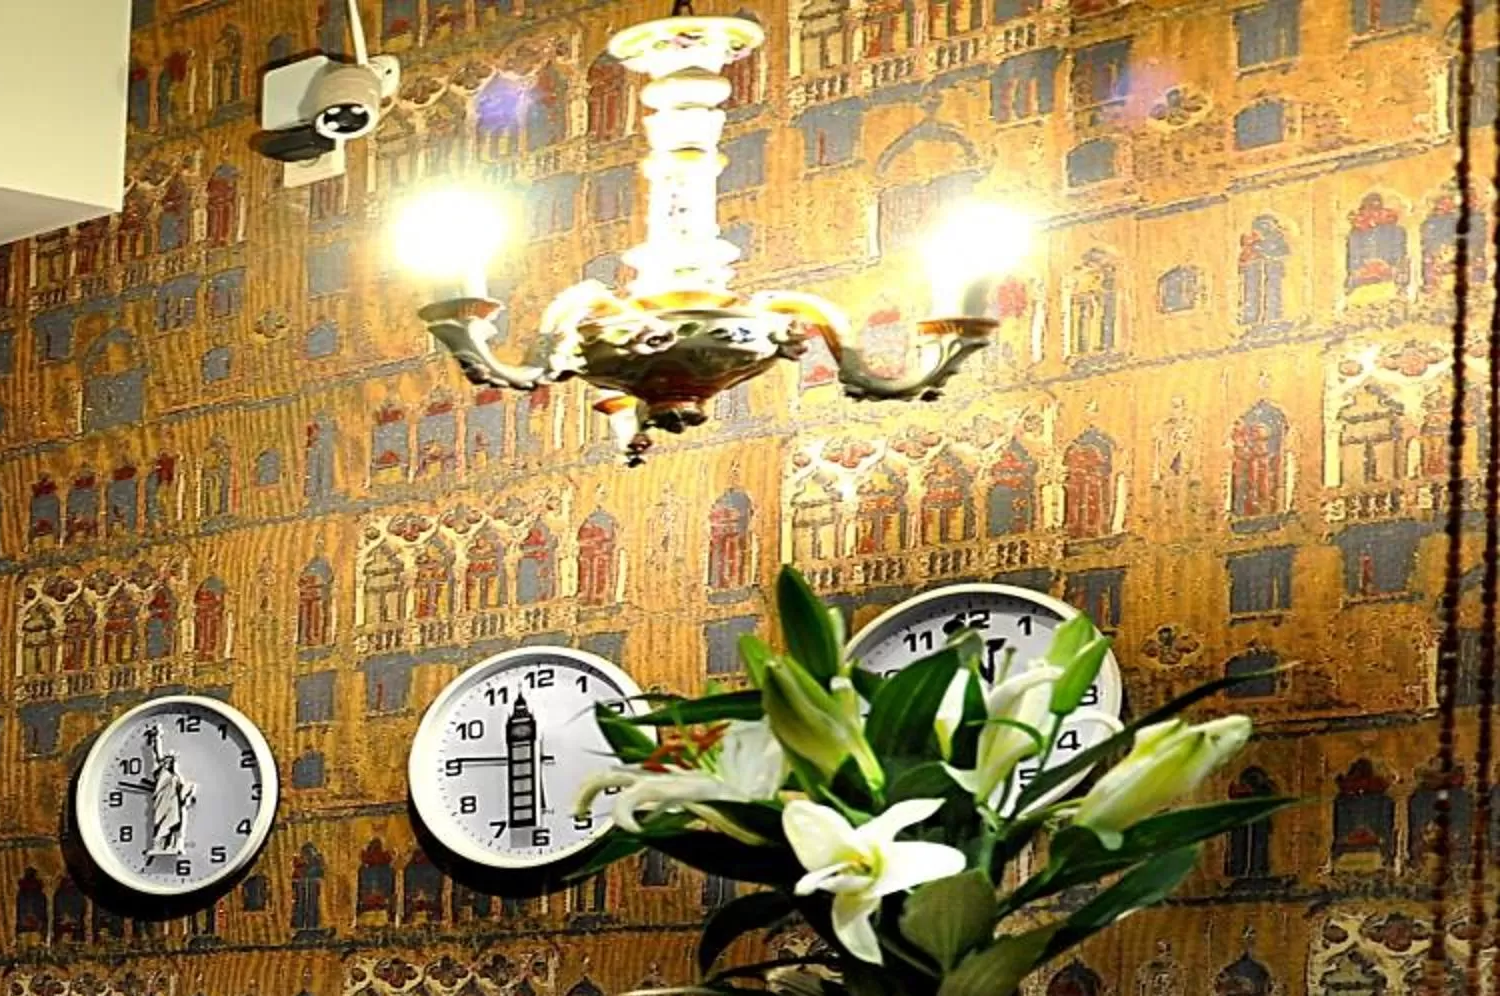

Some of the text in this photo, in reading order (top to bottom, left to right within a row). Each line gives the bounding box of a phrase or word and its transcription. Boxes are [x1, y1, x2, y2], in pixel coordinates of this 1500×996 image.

[1017, 615, 1032, 636] 1
[903, 631, 933, 652] 11
[524, 669, 555, 688] 12
[576, 676, 588, 693] 1
[485, 687, 508, 706] 11
[176, 716, 201, 732] 12
[218, 724, 228, 740] 1
[456, 720, 484, 740] 10
[1057, 730, 1081, 750] 4
[120, 758, 142, 774] 10
[241, 751, 256, 768] 2
[445, 760, 462, 776] 9
[109, 792, 123, 807] 9
[460, 796, 477, 813] 8
[120, 826, 133, 842] 8
[236, 819, 252, 835] 4
[490, 822, 507, 839] 7
[532, 829, 550, 846] 6
[211, 847, 226, 862] 5
[176, 860, 191, 875] 6
